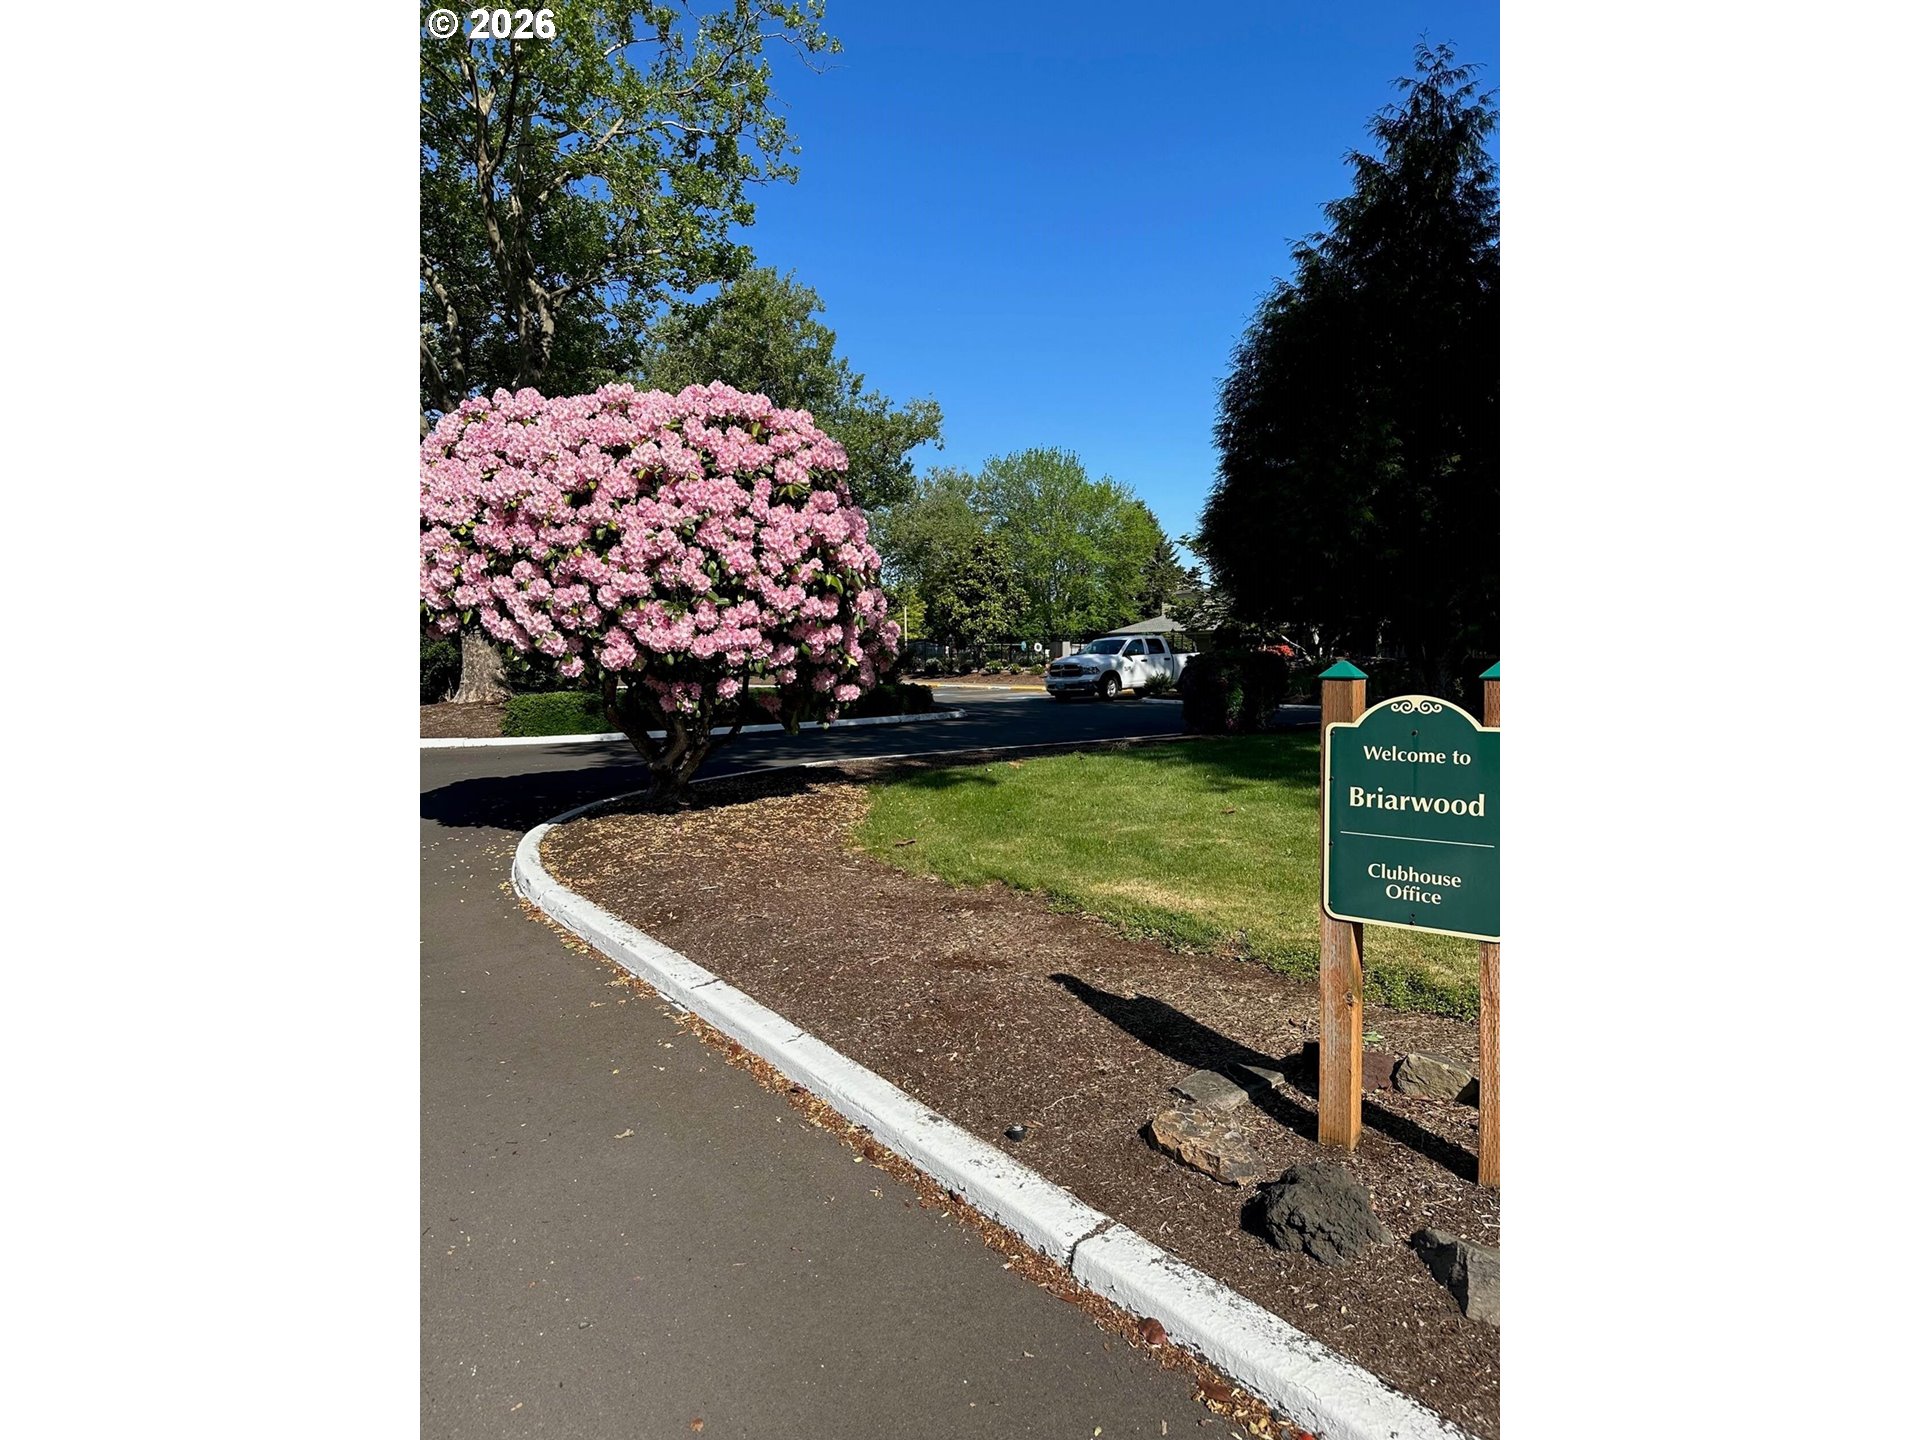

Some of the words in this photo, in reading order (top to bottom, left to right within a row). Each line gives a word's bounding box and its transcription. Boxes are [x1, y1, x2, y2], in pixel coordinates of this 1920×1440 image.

[1363, 746, 1446, 764] Welcome
[1453, 750, 1471, 765] to
[1349, 786, 1485, 817] Briarwood
[1367, 863, 1462, 888] Clubhouse
[1385, 884, 1442, 905] Office
